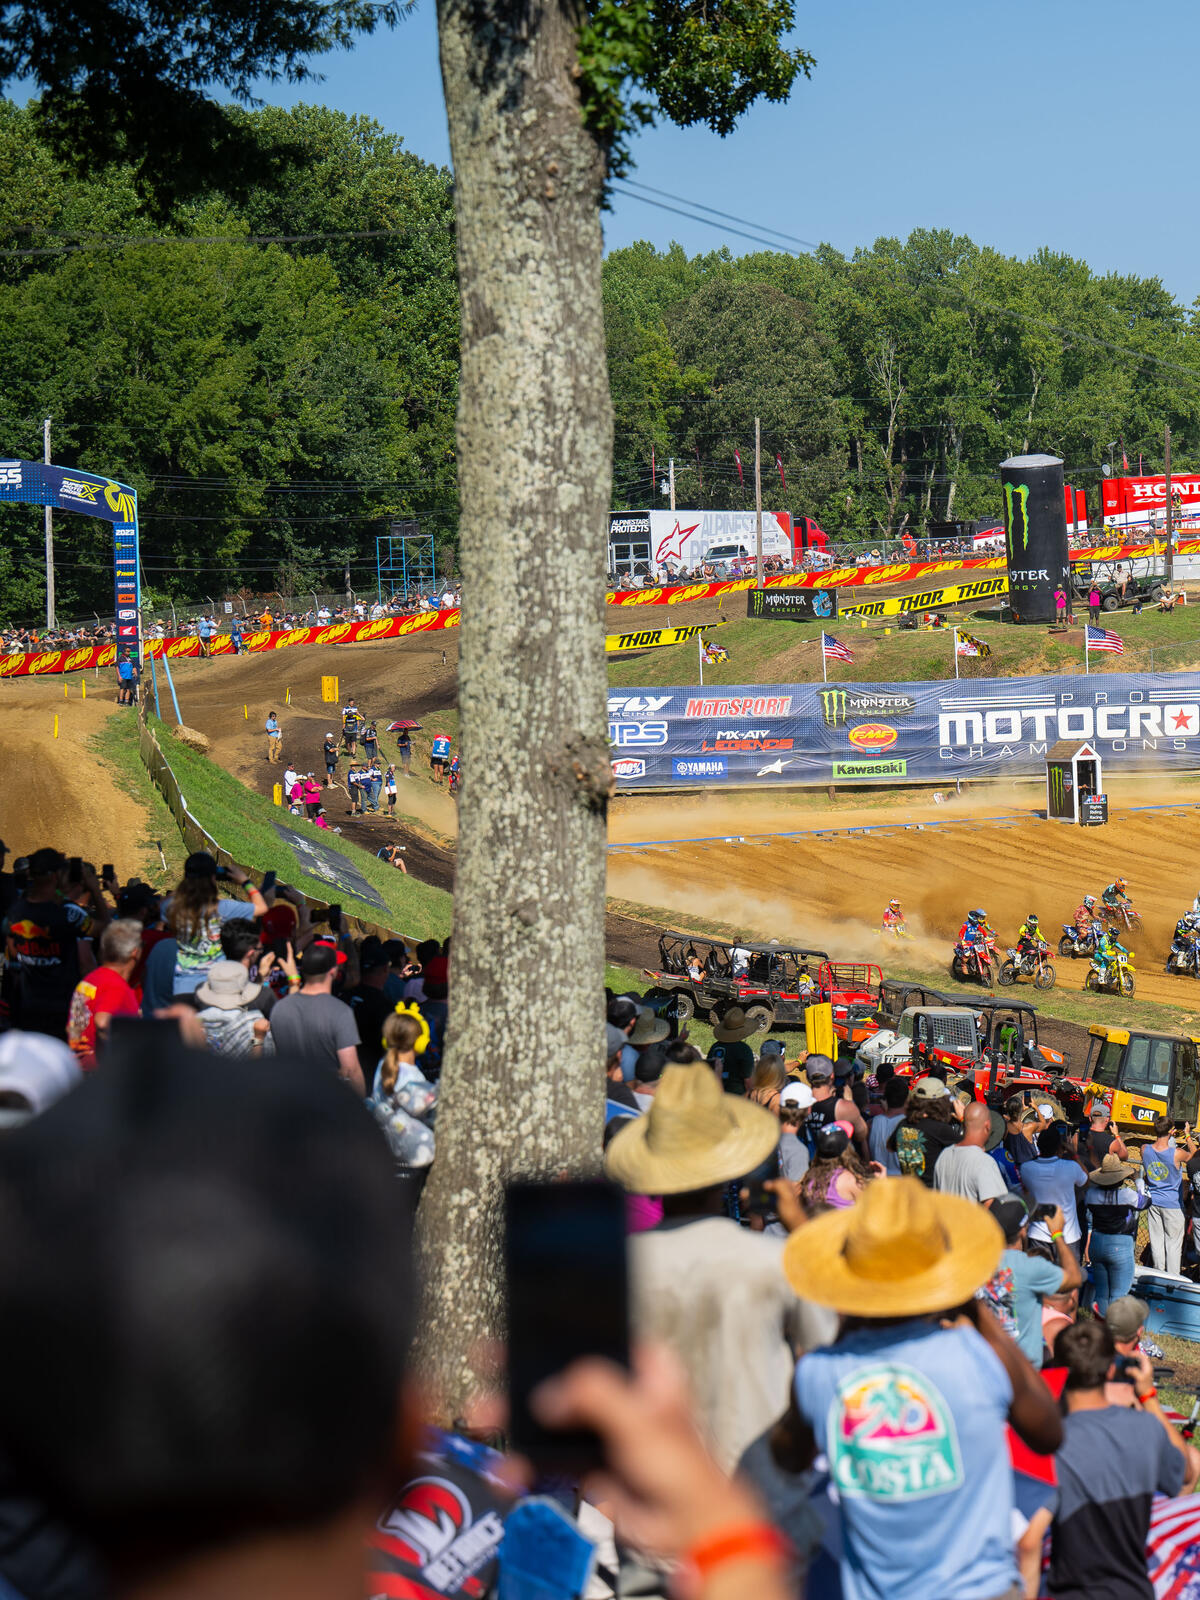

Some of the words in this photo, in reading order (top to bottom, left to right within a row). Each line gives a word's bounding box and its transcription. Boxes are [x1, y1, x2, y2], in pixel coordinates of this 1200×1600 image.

[610, 526, 650, 534] PROTECTS
[611, 518, 650, 526] ALPINESTARS
[813, 568, 858, 587] FMF
[864, 564, 910, 584] FMF
[668, 584, 709, 605] FMF
[958, 578, 1004, 598] THOR
[766, 594, 806, 608] MONSTER
[899, 590, 944, 612] THOR
[356, 618, 393, 640] FMF
[400, 612, 438, 635] FMF
[276, 628, 310, 648] FMF
[316, 624, 350, 644] FMF
[619, 630, 662, 648] THOR
[167, 636, 198, 658] FMF
[30, 651, 60, 674] FMF
[64, 648, 92, 672] FMF
[608, 696, 674, 712] FLY
[850, 697, 910, 708] MONSTER
[1061, 692, 1144, 704] PRO
[853, 730, 893, 740] FMF
[702, 738, 794, 752] LEGENDS
[616, 763, 641, 774] 100%
[687, 762, 724, 772] YAMAHA
[837, 762, 903, 775] Kawasaki
[1138, 1108, 1155, 1122] CAT
